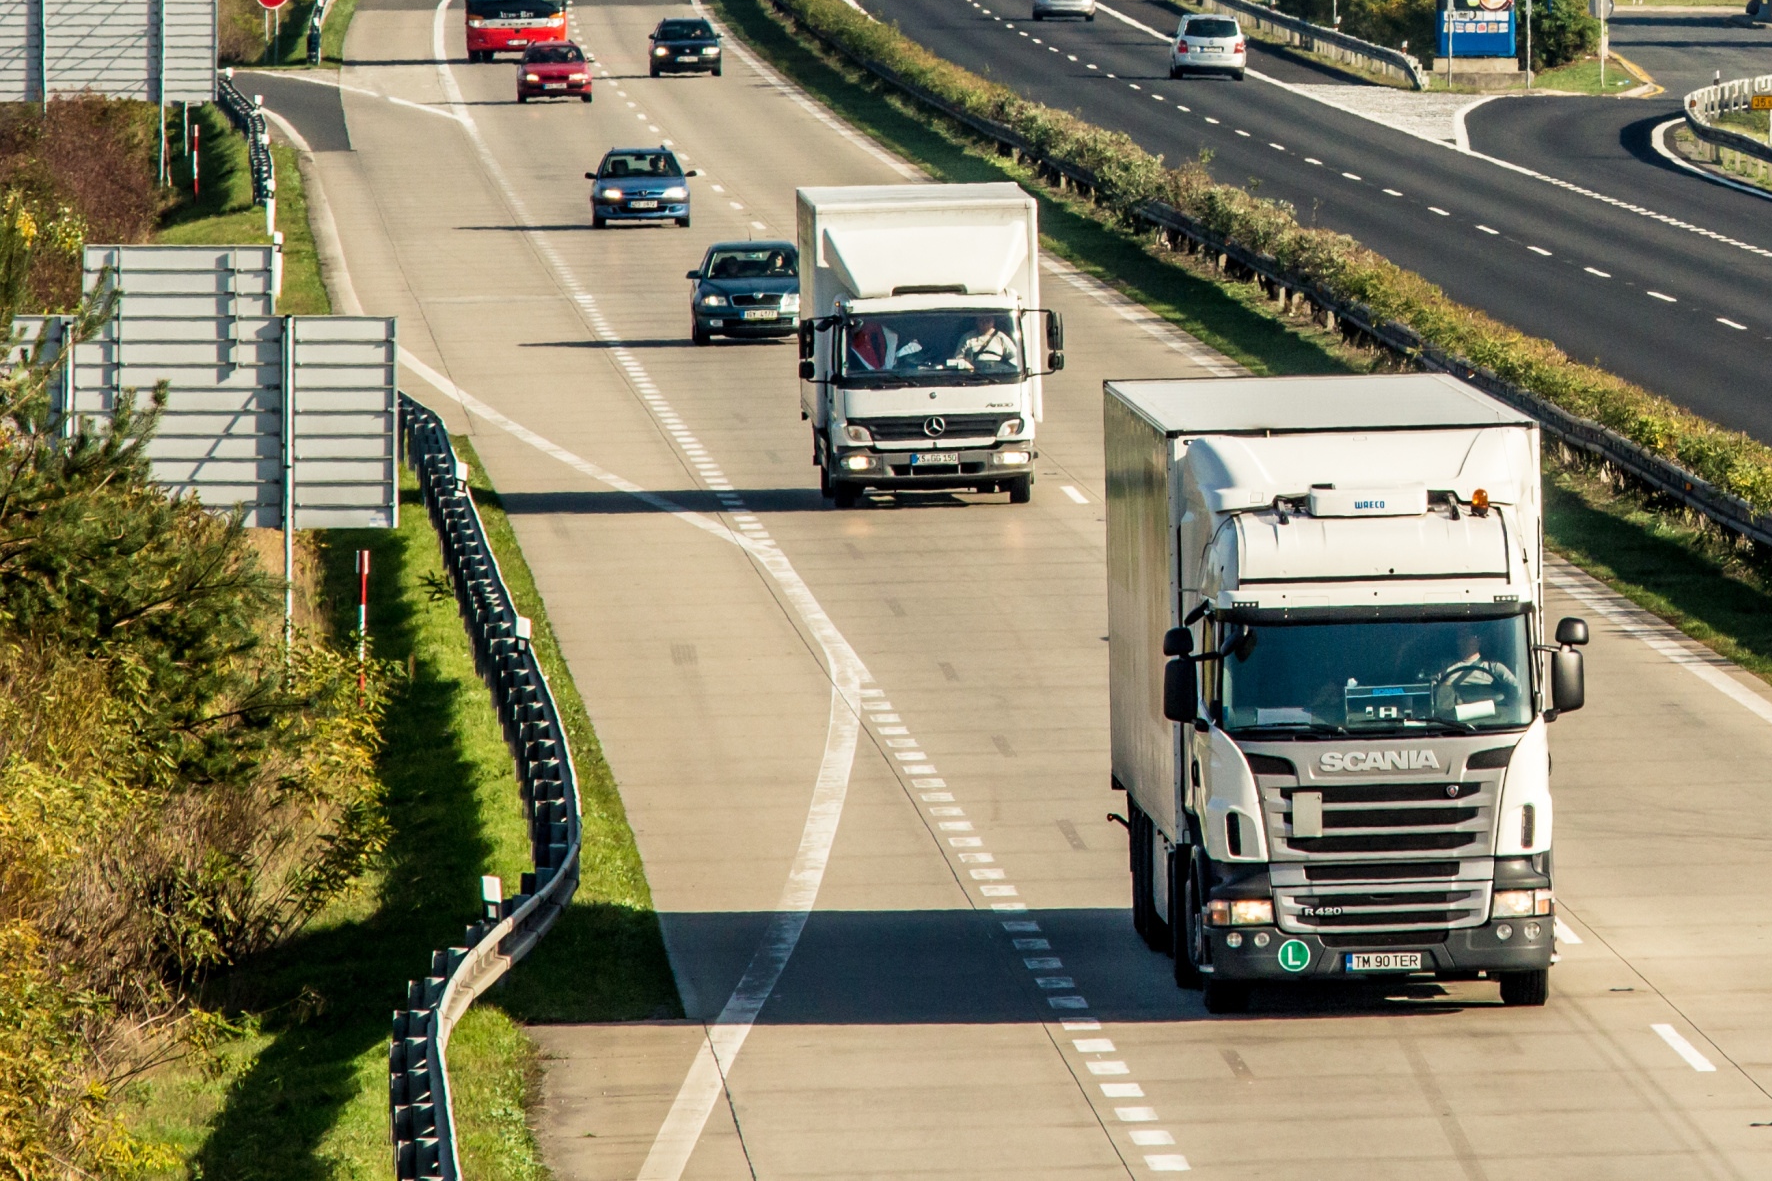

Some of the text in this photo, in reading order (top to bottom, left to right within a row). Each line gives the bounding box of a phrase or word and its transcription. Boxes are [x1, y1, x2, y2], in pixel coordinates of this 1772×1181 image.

[1354, 501, 1385, 509] WAECO
[1372, 688, 1405, 696] SCANIA
[1320, 749, 1440, 772] SCANIA
[1304, 907, 1342, 916] R 420
[1288, 946, 1301, 966] L
[1355, 955, 1418, 968] TM 90 TER
